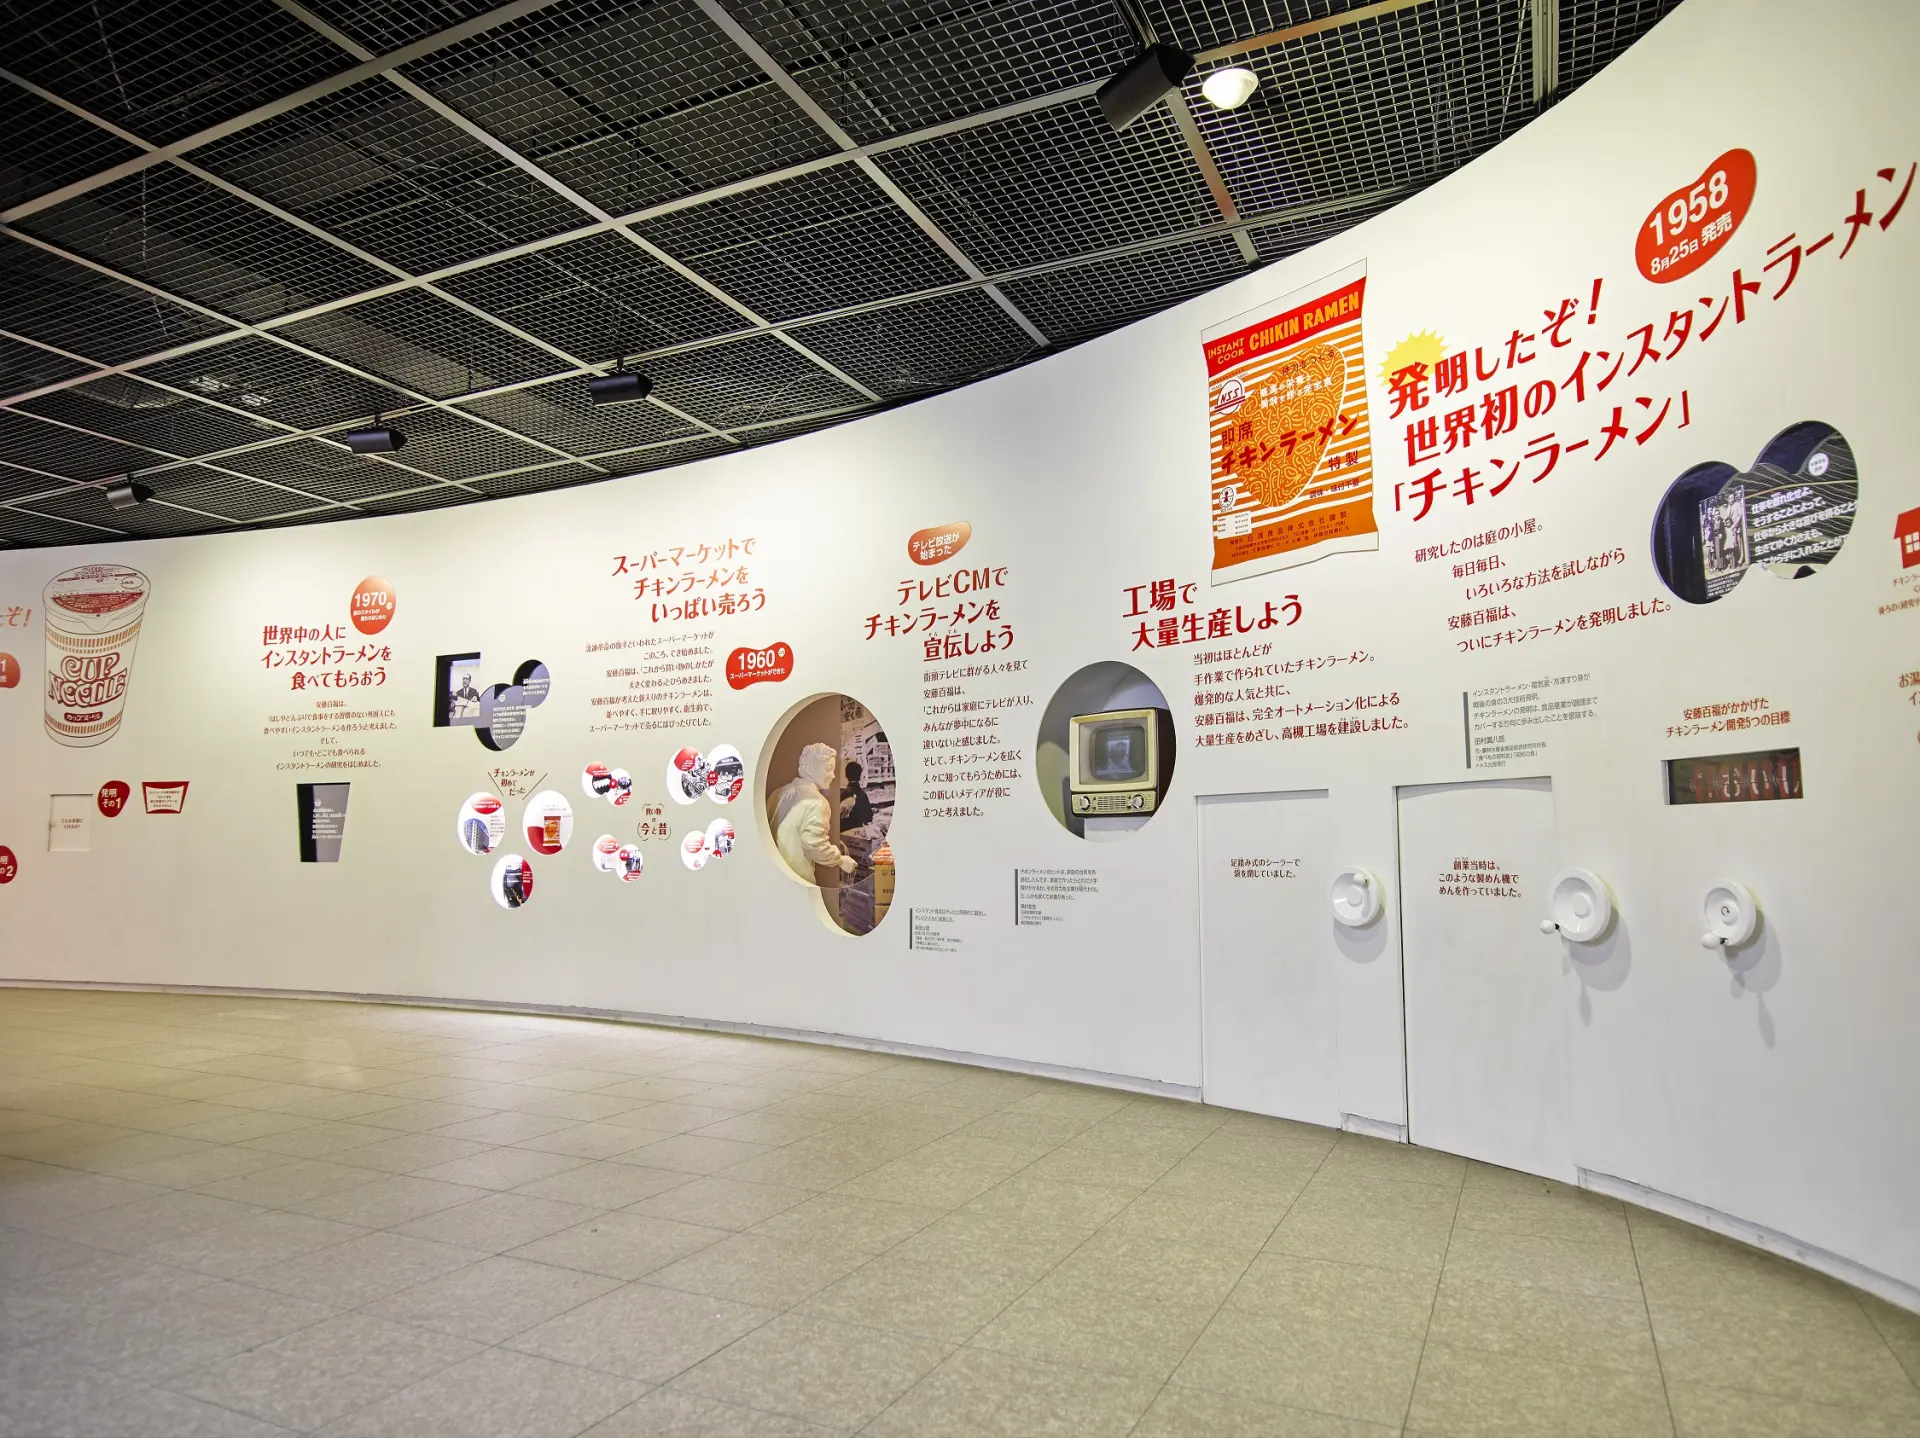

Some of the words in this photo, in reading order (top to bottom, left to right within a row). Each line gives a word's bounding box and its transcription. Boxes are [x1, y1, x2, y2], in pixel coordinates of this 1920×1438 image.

[1649, 169, 1729, 247] 1958
[1651, 238, 1699, 275] 8月25日
[1701, 210, 1733, 246] 発売
[1249, 316, 1300, 351] CHIKIN
[1303, 291, 1360, 329] RAMEN
[1404, 161, 1918, 467] 世界初のインスタントラーメン
[1208, 337, 1245, 359] INSTANT
[1217, 348, 1245, 365] COOK
[1221, 387, 1239, 404] NSS
[1221, 420, 1253, 448] 即席
[1221, 414, 1358, 474] チキンラーメン
[1328, 449, 1359, 471] 特製
[1394, 390, 1691, 522] 「チキンラーメン」
[912, 532, 960, 552] テレビ放送が
[1415, 518, 1543, 563] 研究したのは庭の小屋。
[612, 537, 756, 576] スーパーマーケットで
[919, 545, 953, 560] 始まった
[1451, 554, 1507, 579] 毎日毎日、
[1466, 547, 1626, 600] いろいろな方法を試しながら
[633, 566, 749, 600] チキンラーメンを
[897, 566, 1009, 606] テレビCMで
[355, 591, 387, 607] 1970
[651, 587, 766, 623] いっぱい売ろう
[1122, 578, 1198, 618] 工場で
[864, 599, 1001, 640] チキンラーメンを
[1131, 594, 1303, 652] 大量生産しよう
[1447, 604, 1517, 631] 安藤百福は、
[1456, 597, 1672, 652] ついにチキンラーメンを発明しました。
[262, 624, 347, 646] 世界中の人に
[923, 624, 1014, 662] 宣伝しよう
[260, 643, 392, 668] インスタントラーメンを
[738, 649, 776, 671] 1960
[1193, 642, 1273, 665] 当初はほとんどが
[60, 652, 120, 682] CUP
[291, 667, 387, 690] 食べてもらおう
[923, 660, 1029, 682] 街頭テレビに群がる人々を見て
[1194, 650, 1375, 686] 手作業で作られていたチキンラーメン。
[923, 686, 966, 699] 安藤百福は、
[1194, 684, 1291, 706] 爆発的な人気と共に、
[923, 695, 1034, 715] 「これからは家庭にテレビが入り、
[1194, 692, 1401, 727] 安藤百福は、完全オートメーション化による
[1683, 697, 1769, 721] 安藤百福がかかげた
[923, 717, 999, 732] みんなが夢中になるに
[1194, 715, 1409, 748] 大量生産をめざし、高槻工場を建設しました。
[1666, 710, 1791, 738] チキンラーメン開発5つの目標
[922, 734, 1001, 750] 違いない」と感じました。
[923, 750, 1022, 766] そして、チキンラーメンを広く
[923, 769, 1022, 784] 人々に知ってもらうためには、
[101, 788, 117, 798] 発明
[102, 797, 121, 809] その1
[923, 787, 1011, 800] この新しいメディアが役に
[923, 806, 984, 818] 立つと考えました。
[640, 822, 668, 836] 今と昔
[1453, 860, 1501, 870] 創業当時は、
[1438, 873, 1520, 884] このような製めん機で
[1438, 886, 1522, 898] めんを作っていました。
